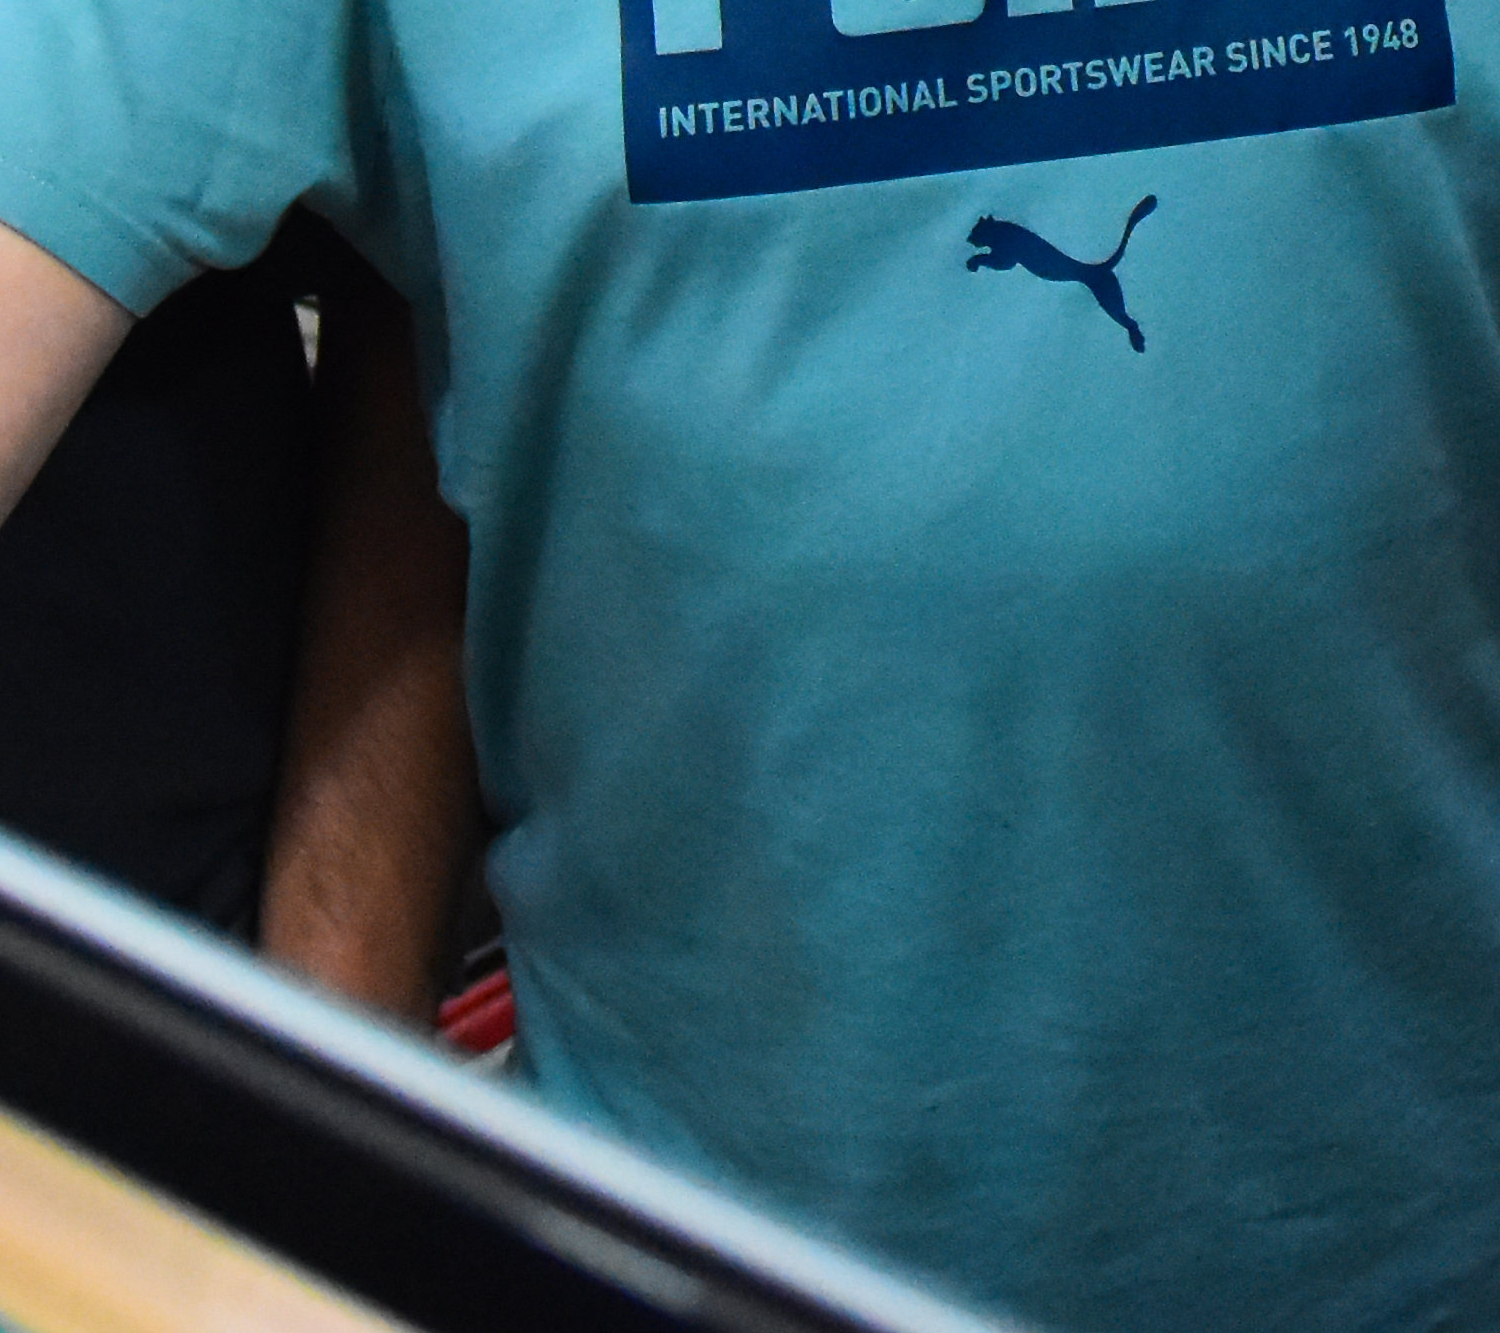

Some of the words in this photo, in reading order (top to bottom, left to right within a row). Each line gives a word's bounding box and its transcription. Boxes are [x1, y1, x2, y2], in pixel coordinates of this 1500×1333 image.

[658, 76, 959, 139] INTERNATIONAL
[966, 45, 1217, 106] SPORTSWEAR
[1226, 29, 1334, 74] SINCE
[1344, 17, 1421, 57] 1948
